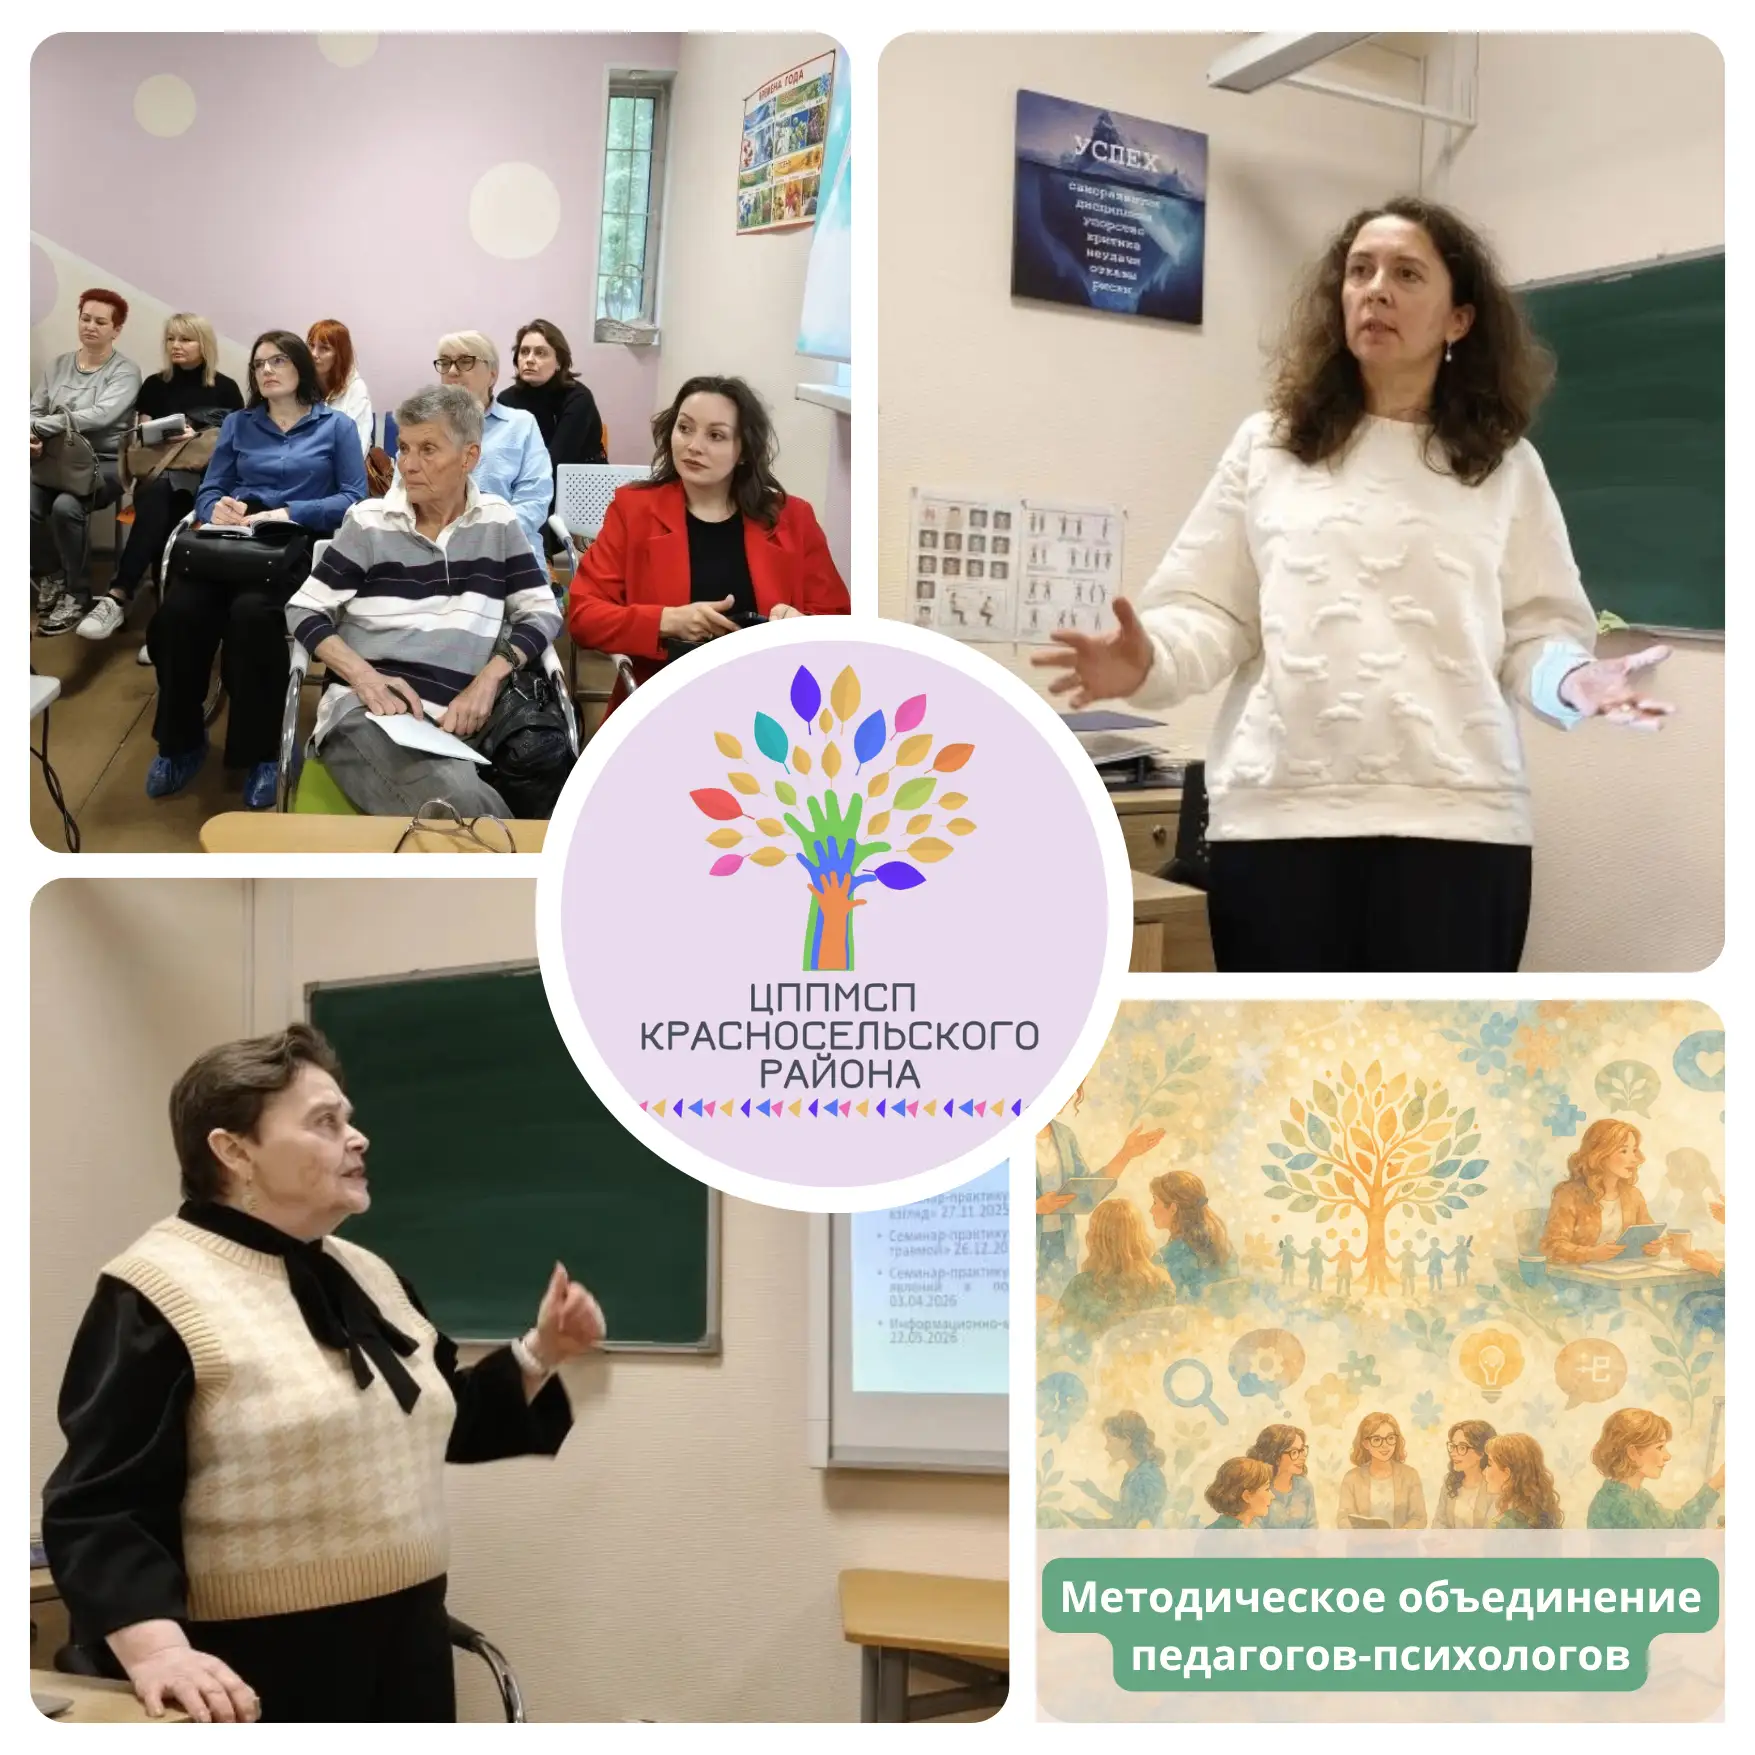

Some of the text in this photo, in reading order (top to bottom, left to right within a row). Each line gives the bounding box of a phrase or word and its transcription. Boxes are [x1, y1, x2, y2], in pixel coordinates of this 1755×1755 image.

[785, 69, 804, 86] ГОДА
[1074, 134, 1159, 173] УСПЕХ
[1082, 215, 1145, 236] упорство
[1086, 232, 1142, 252] критика
[1086, 247, 1142, 267] неудачи
[1088, 264, 1138, 281] отказы
[889, 1294, 958, 1308] 03.04.2026
[889, 1331, 959, 1344] 22.05.2026
